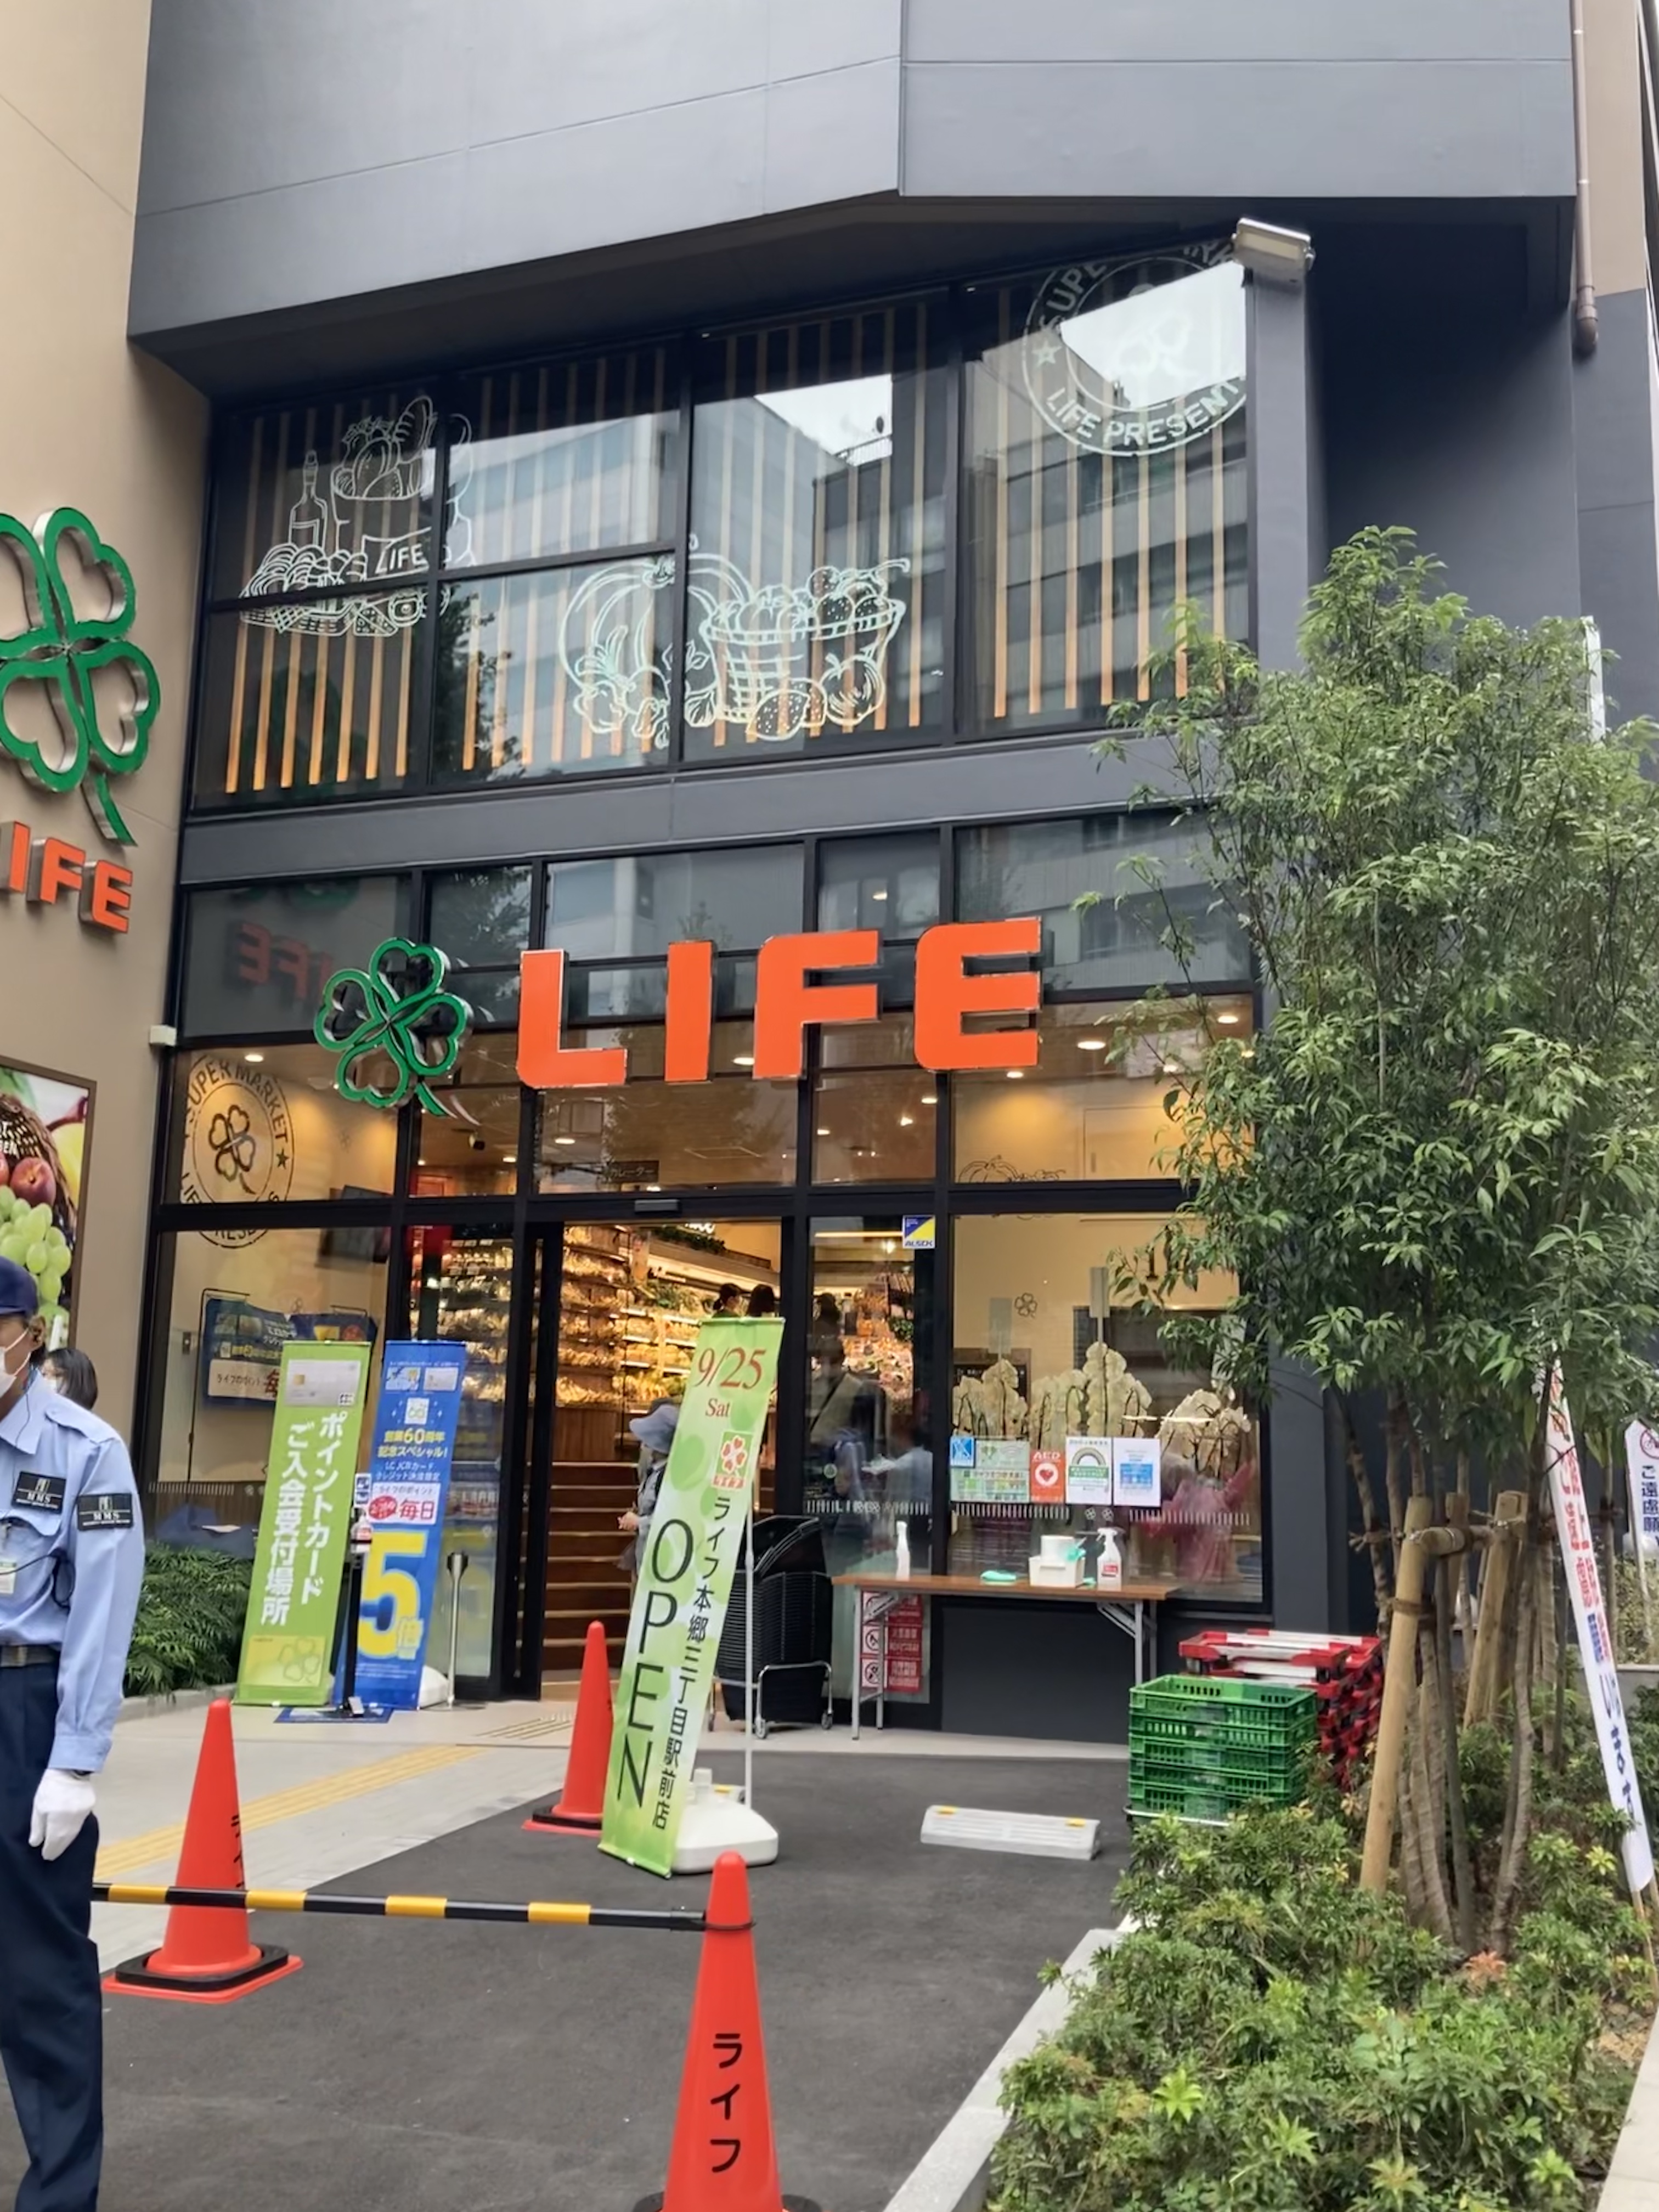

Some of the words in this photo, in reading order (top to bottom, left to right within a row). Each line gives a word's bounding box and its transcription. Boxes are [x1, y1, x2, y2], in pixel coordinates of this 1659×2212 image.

[1047, 387, 1101, 438] LIFE
[375, 544, 428, 574] LIFE
[516, 917, 1042, 1089] LIFE
[235, 1064, 289, 1143] MARKET
[693, 1347, 767, 1390] 9/25
[705, 1398, 731, 1418] Sat
[261, 1421, 315, 1626] ご入会受付場所
[302, 1410, 348, 1605] ポイントカード
[617, 1519, 693, 1808] OPEN
[652, 1497, 731, 1830] ライフ本郷三丁目駅前店
[710, 2033, 743, 2173] ライフ
